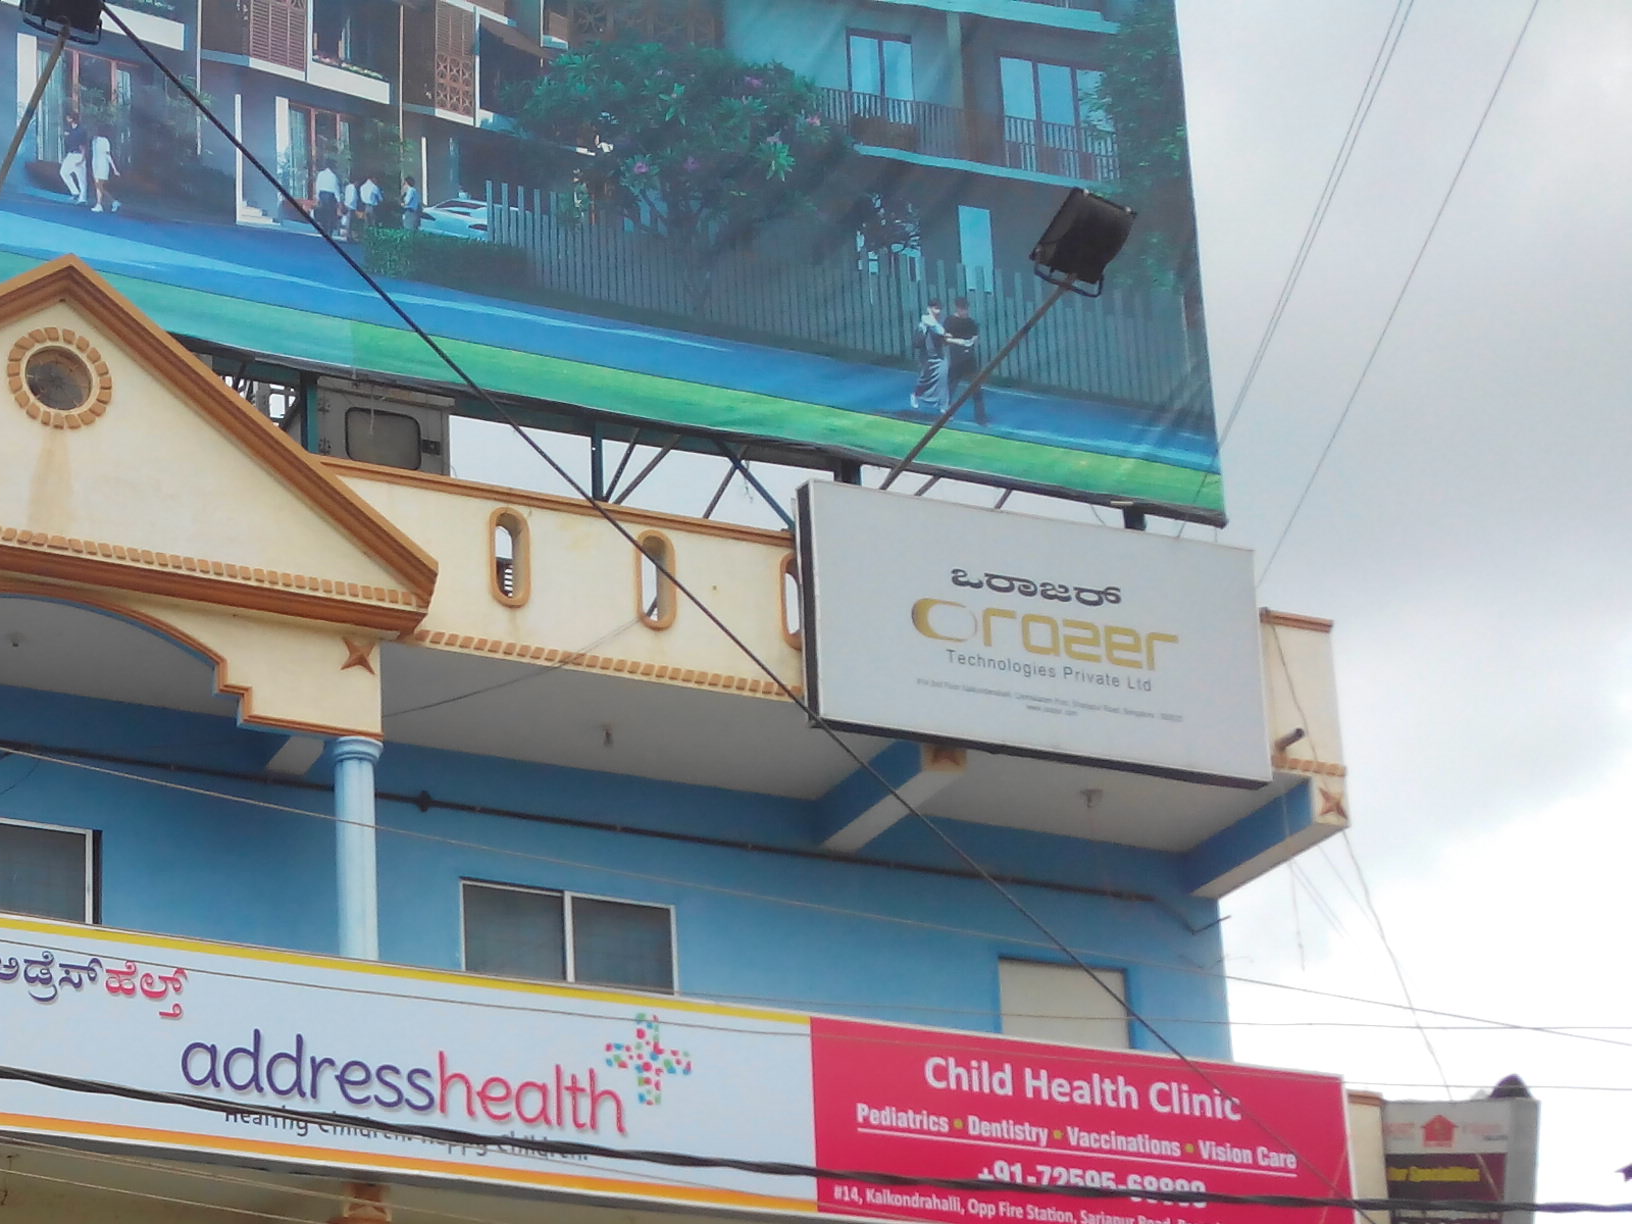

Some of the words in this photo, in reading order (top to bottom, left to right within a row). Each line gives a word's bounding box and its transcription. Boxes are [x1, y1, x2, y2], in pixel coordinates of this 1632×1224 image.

[945, 648, 1057, 681] Technologies
[1062, 665, 1121, 689] Private
[1126, 676, 1152, 693] Ltd
[180, 1027, 626, 1134] addresshealth
[924, 1056, 1014, 1097] Child
[1024, 1067, 1139, 1110] Health
[1148, 1080, 1242, 1121] Clinic
[856, 1102, 950, 1133] Pediatrics
[967, 1114, 1049, 1147] Dentistry
[1066, 1125, 1182, 1158] Vaccinations
[1198, 1139, 1253, 1165] Vision
[1257, 1146, 1298, 1170] Care
[833, 1184, 864, 1206] #14,
[968, 1198, 996, 1219] Opp
[998, 1200, 1024, 1219] Fire
